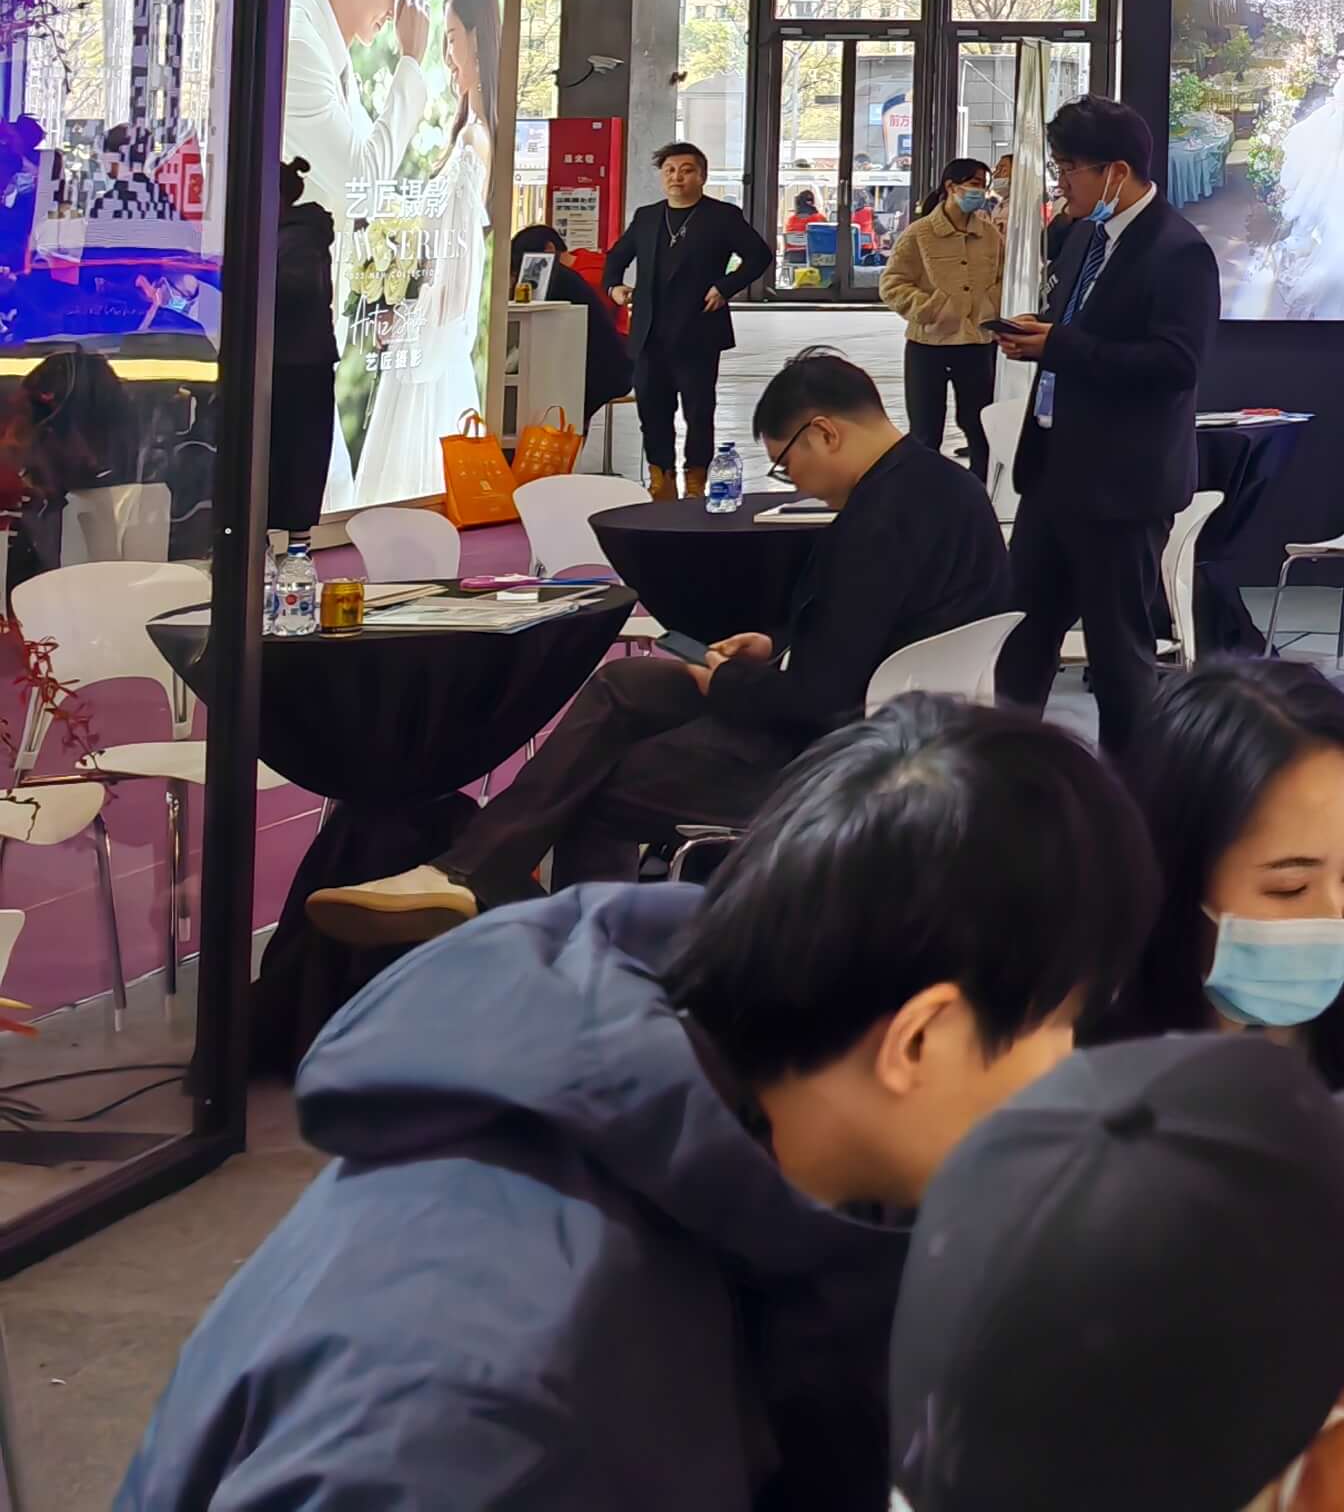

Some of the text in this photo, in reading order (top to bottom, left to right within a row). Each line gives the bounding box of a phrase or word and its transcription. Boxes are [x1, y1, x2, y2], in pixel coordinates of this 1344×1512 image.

[344, 176, 449, 219] 艺匠摄影
[385, 229, 469, 262] SERIES
[390, 268, 440, 281] COLLECTIO
